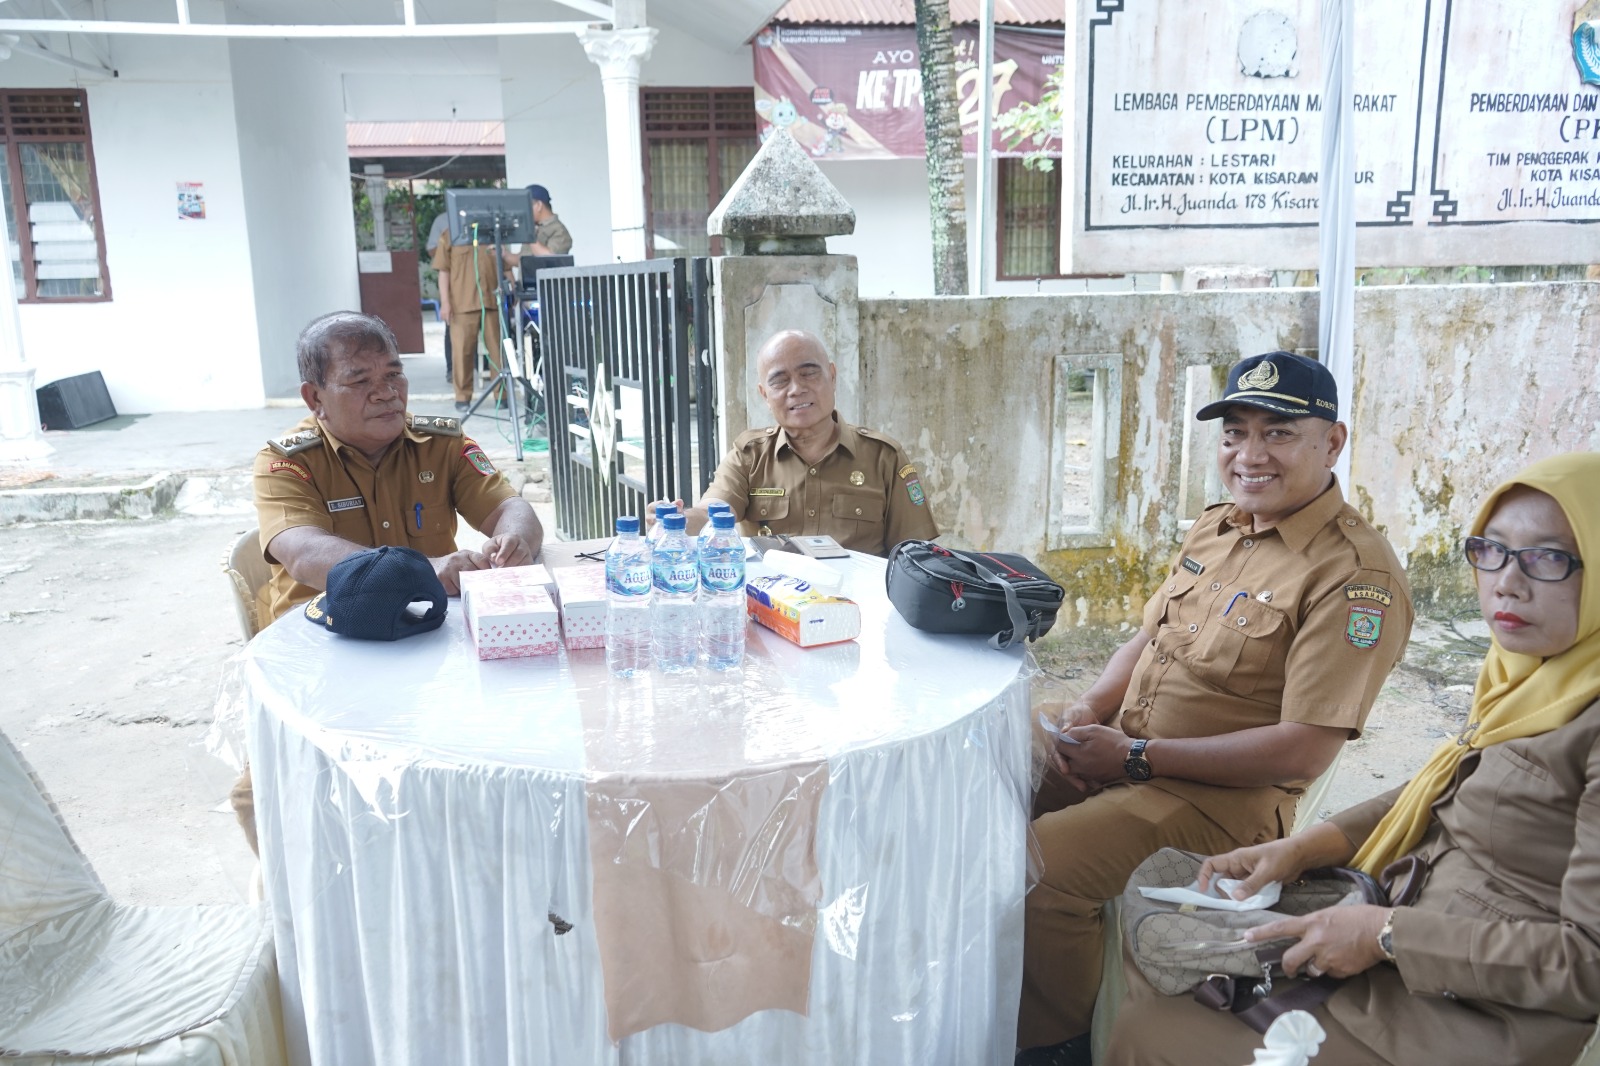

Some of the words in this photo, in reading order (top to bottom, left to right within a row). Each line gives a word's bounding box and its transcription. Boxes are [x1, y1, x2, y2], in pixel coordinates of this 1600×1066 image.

[872, 50, 914, 64] AYO
[1042, 55, 1064, 64] UNTU
[856, 70, 889, 109] KE
[956, 59, 1018, 126] 27
[1114, 93, 1178, 111] LEMBAGA
[1186, 94, 1300, 111] PEMBERDAYAAN
[1306, 94, 1397, 112] MRAKAT
[1470, 93, 1569, 112] PEMBERDAYAAN
[1573, 93, 1598, 111] DAN
[1206, 116, 1299, 144] (LPM)
[1113, 155, 1193, 168] KELURAHAN
[1211, 154, 1276, 167] LESTARI
[1487, 152, 1510, 166] TIM
[1516, 151, 1590, 166] PENGGERAK
[1112, 173, 1194, 186] KECAMATAN
[1209, 172, 1246, 184] KOTA
[1254, 171, 1318, 185] KISARAN
[1530, 169, 1563, 181] KOTA
[1245, 193, 1266, 209] 178
[624, 570, 651, 584] AQUA
[669, 568, 696, 581] AQUA
[708, 567, 737, 580] AQUA
[1354, 591, 1386, 602] ASAHAN
